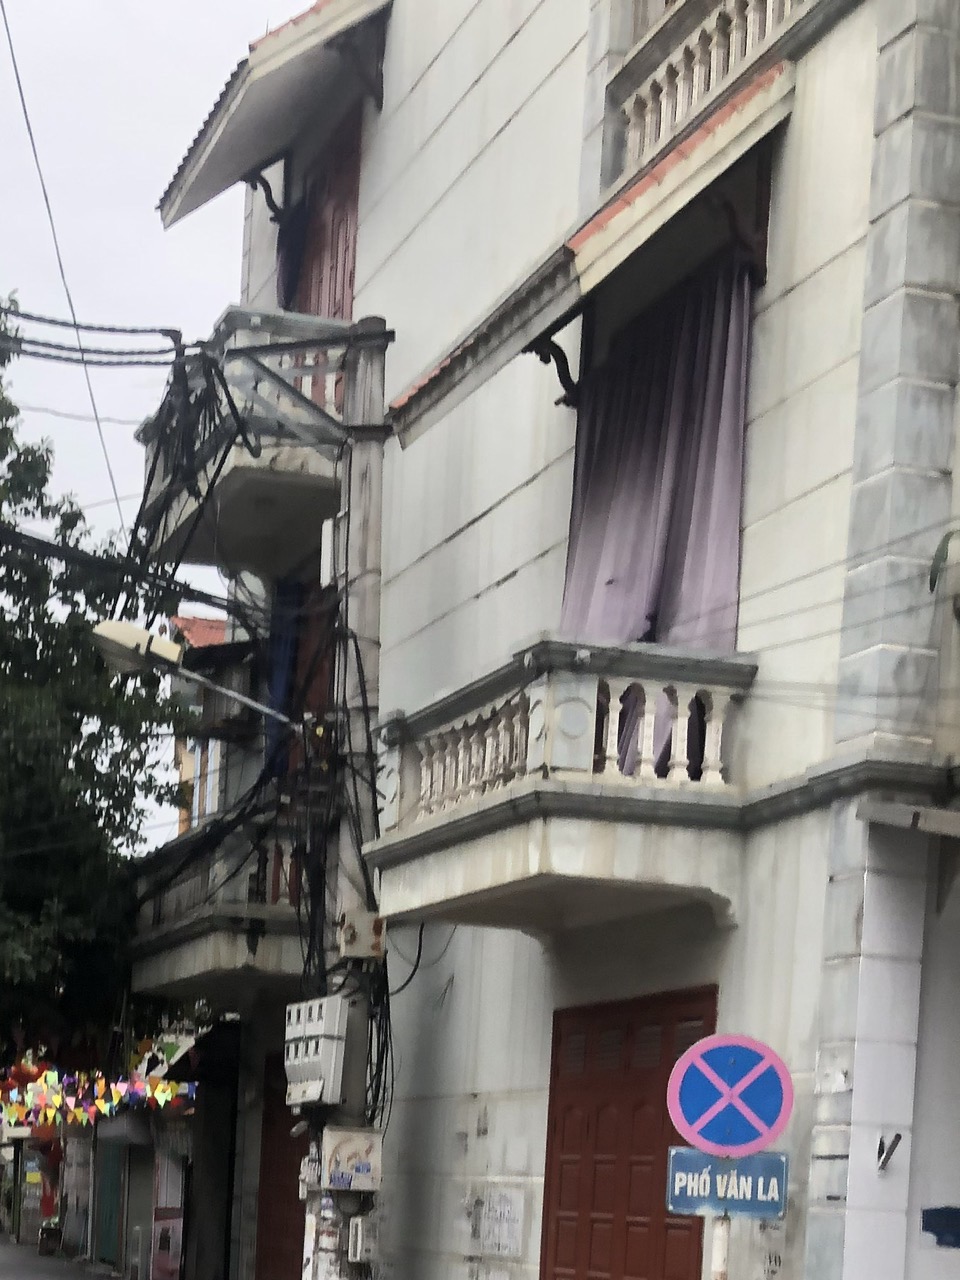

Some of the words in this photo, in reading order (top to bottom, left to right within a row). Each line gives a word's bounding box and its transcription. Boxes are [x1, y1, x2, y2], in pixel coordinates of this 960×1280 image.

[674, 1165, 712, 1197] PHỐ
[716, 1169, 752, 1201] VĂN
[757, 1176, 779, 1201] LA
